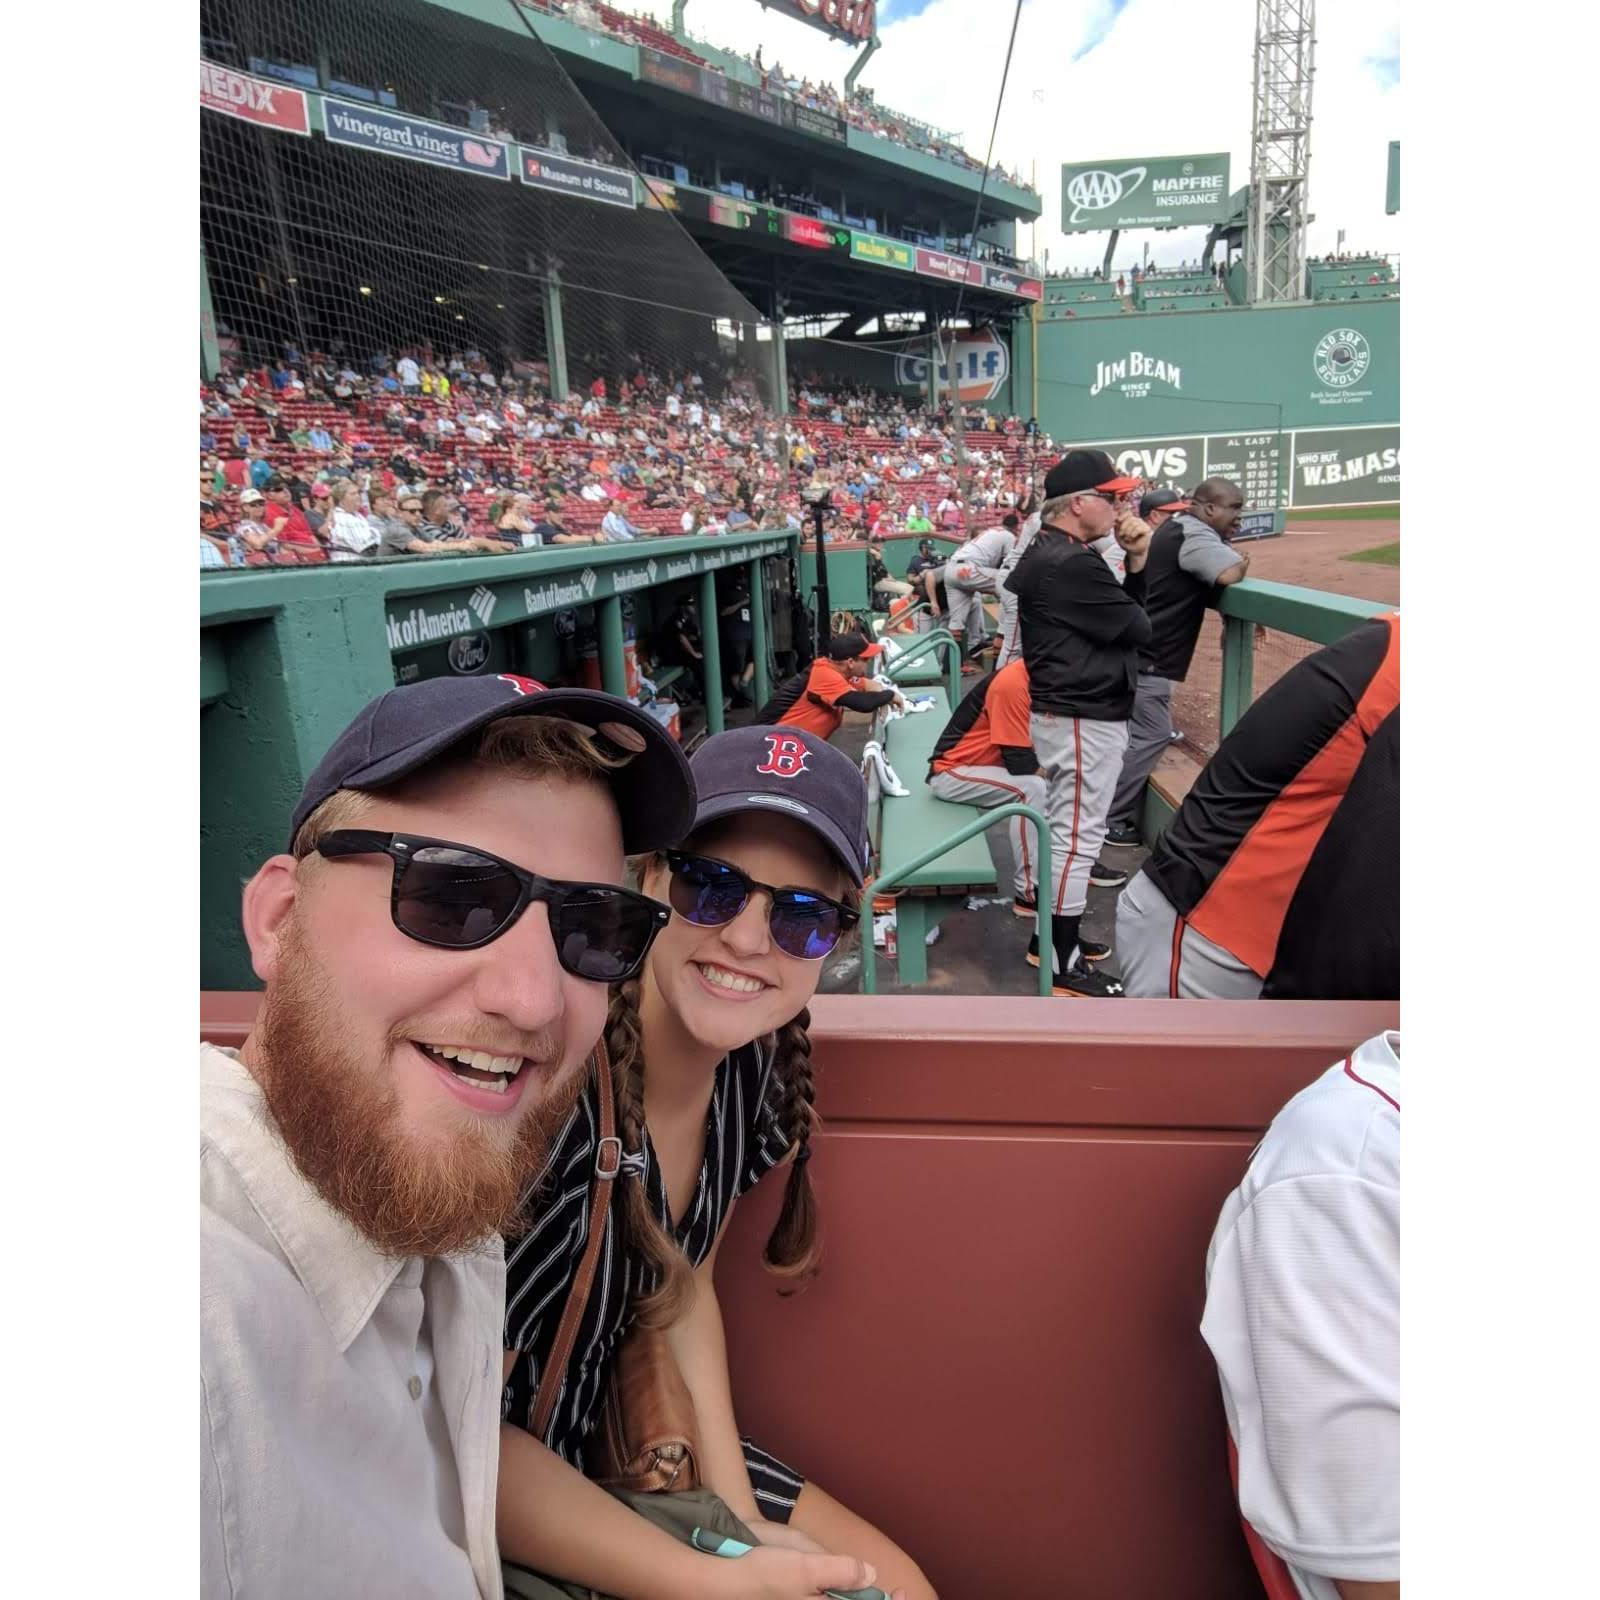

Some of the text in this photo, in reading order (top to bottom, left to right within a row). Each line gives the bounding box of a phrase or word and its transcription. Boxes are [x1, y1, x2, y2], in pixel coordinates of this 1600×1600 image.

[332, 111, 411, 146] vineyard
[413, 132, 459, 157] vines
[541, 165, 581, 187] Museum
[582, 176, 593, 188] of
[594, 178, 629, 198] Science
[1152, 175, 1224, 192] MAPFRE
[1156, 193, 1219, 207] INSURANCE
[1317, 331, 1361, 357] RED SOX
[903, 350, 999, 381] Gulf
[1090, 351, 1181, 397] JIM BEAM
[1318, 351, 1367, 385] SCHOLARS
[1120, 382, 1151, 391] SINCE
[1227, 436, 1272, 447] AL EAST
[1116, 446, 1187, 478] CVS
[1207, 463, 1236, 472] BOSTON
[1297, 452, 1338, 465] WHO BUT
[1303, 448, 1400, 487] W.B.MAS
[524, 584, 546, 614] Bank
[553, 579, 583, 607] America
[402, 608, 419, 646] of
[418, 602, 472, 642] America
[756, 733, 813, 778] B
